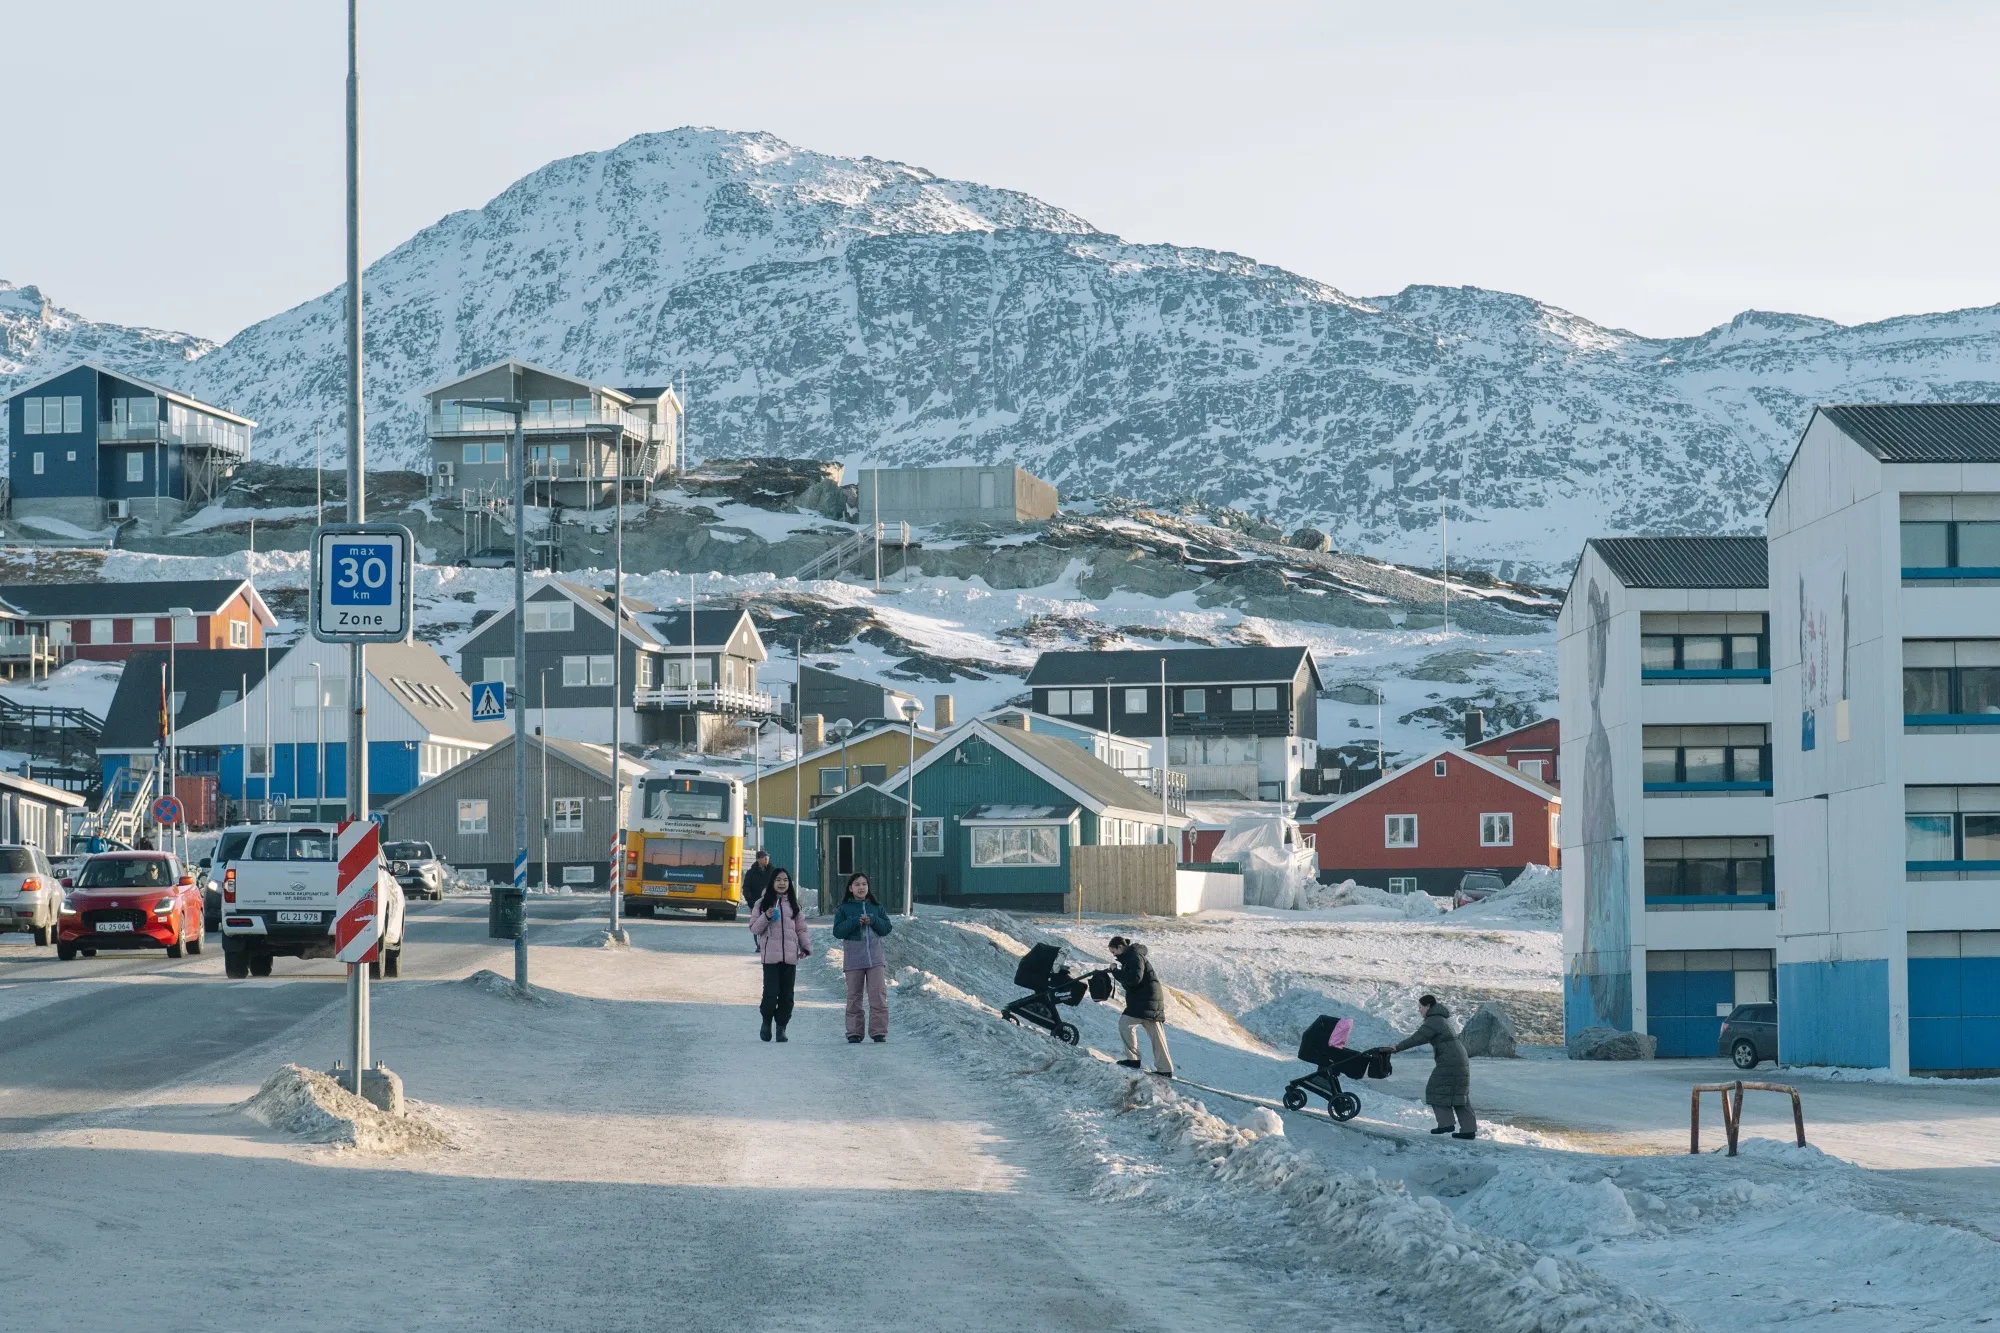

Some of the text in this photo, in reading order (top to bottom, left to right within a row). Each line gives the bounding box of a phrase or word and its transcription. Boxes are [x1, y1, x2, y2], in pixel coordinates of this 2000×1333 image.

[349, 547, 375, 556] max
[337, 557, 387, 589] 30
[353, 590, 370, 599] km
[339, 612, 383, 625] Zone
[685, 779, 691, 792] 1
[280, 913, 319, 921] GL 21 978
[98, 923, 107, 931] GL
